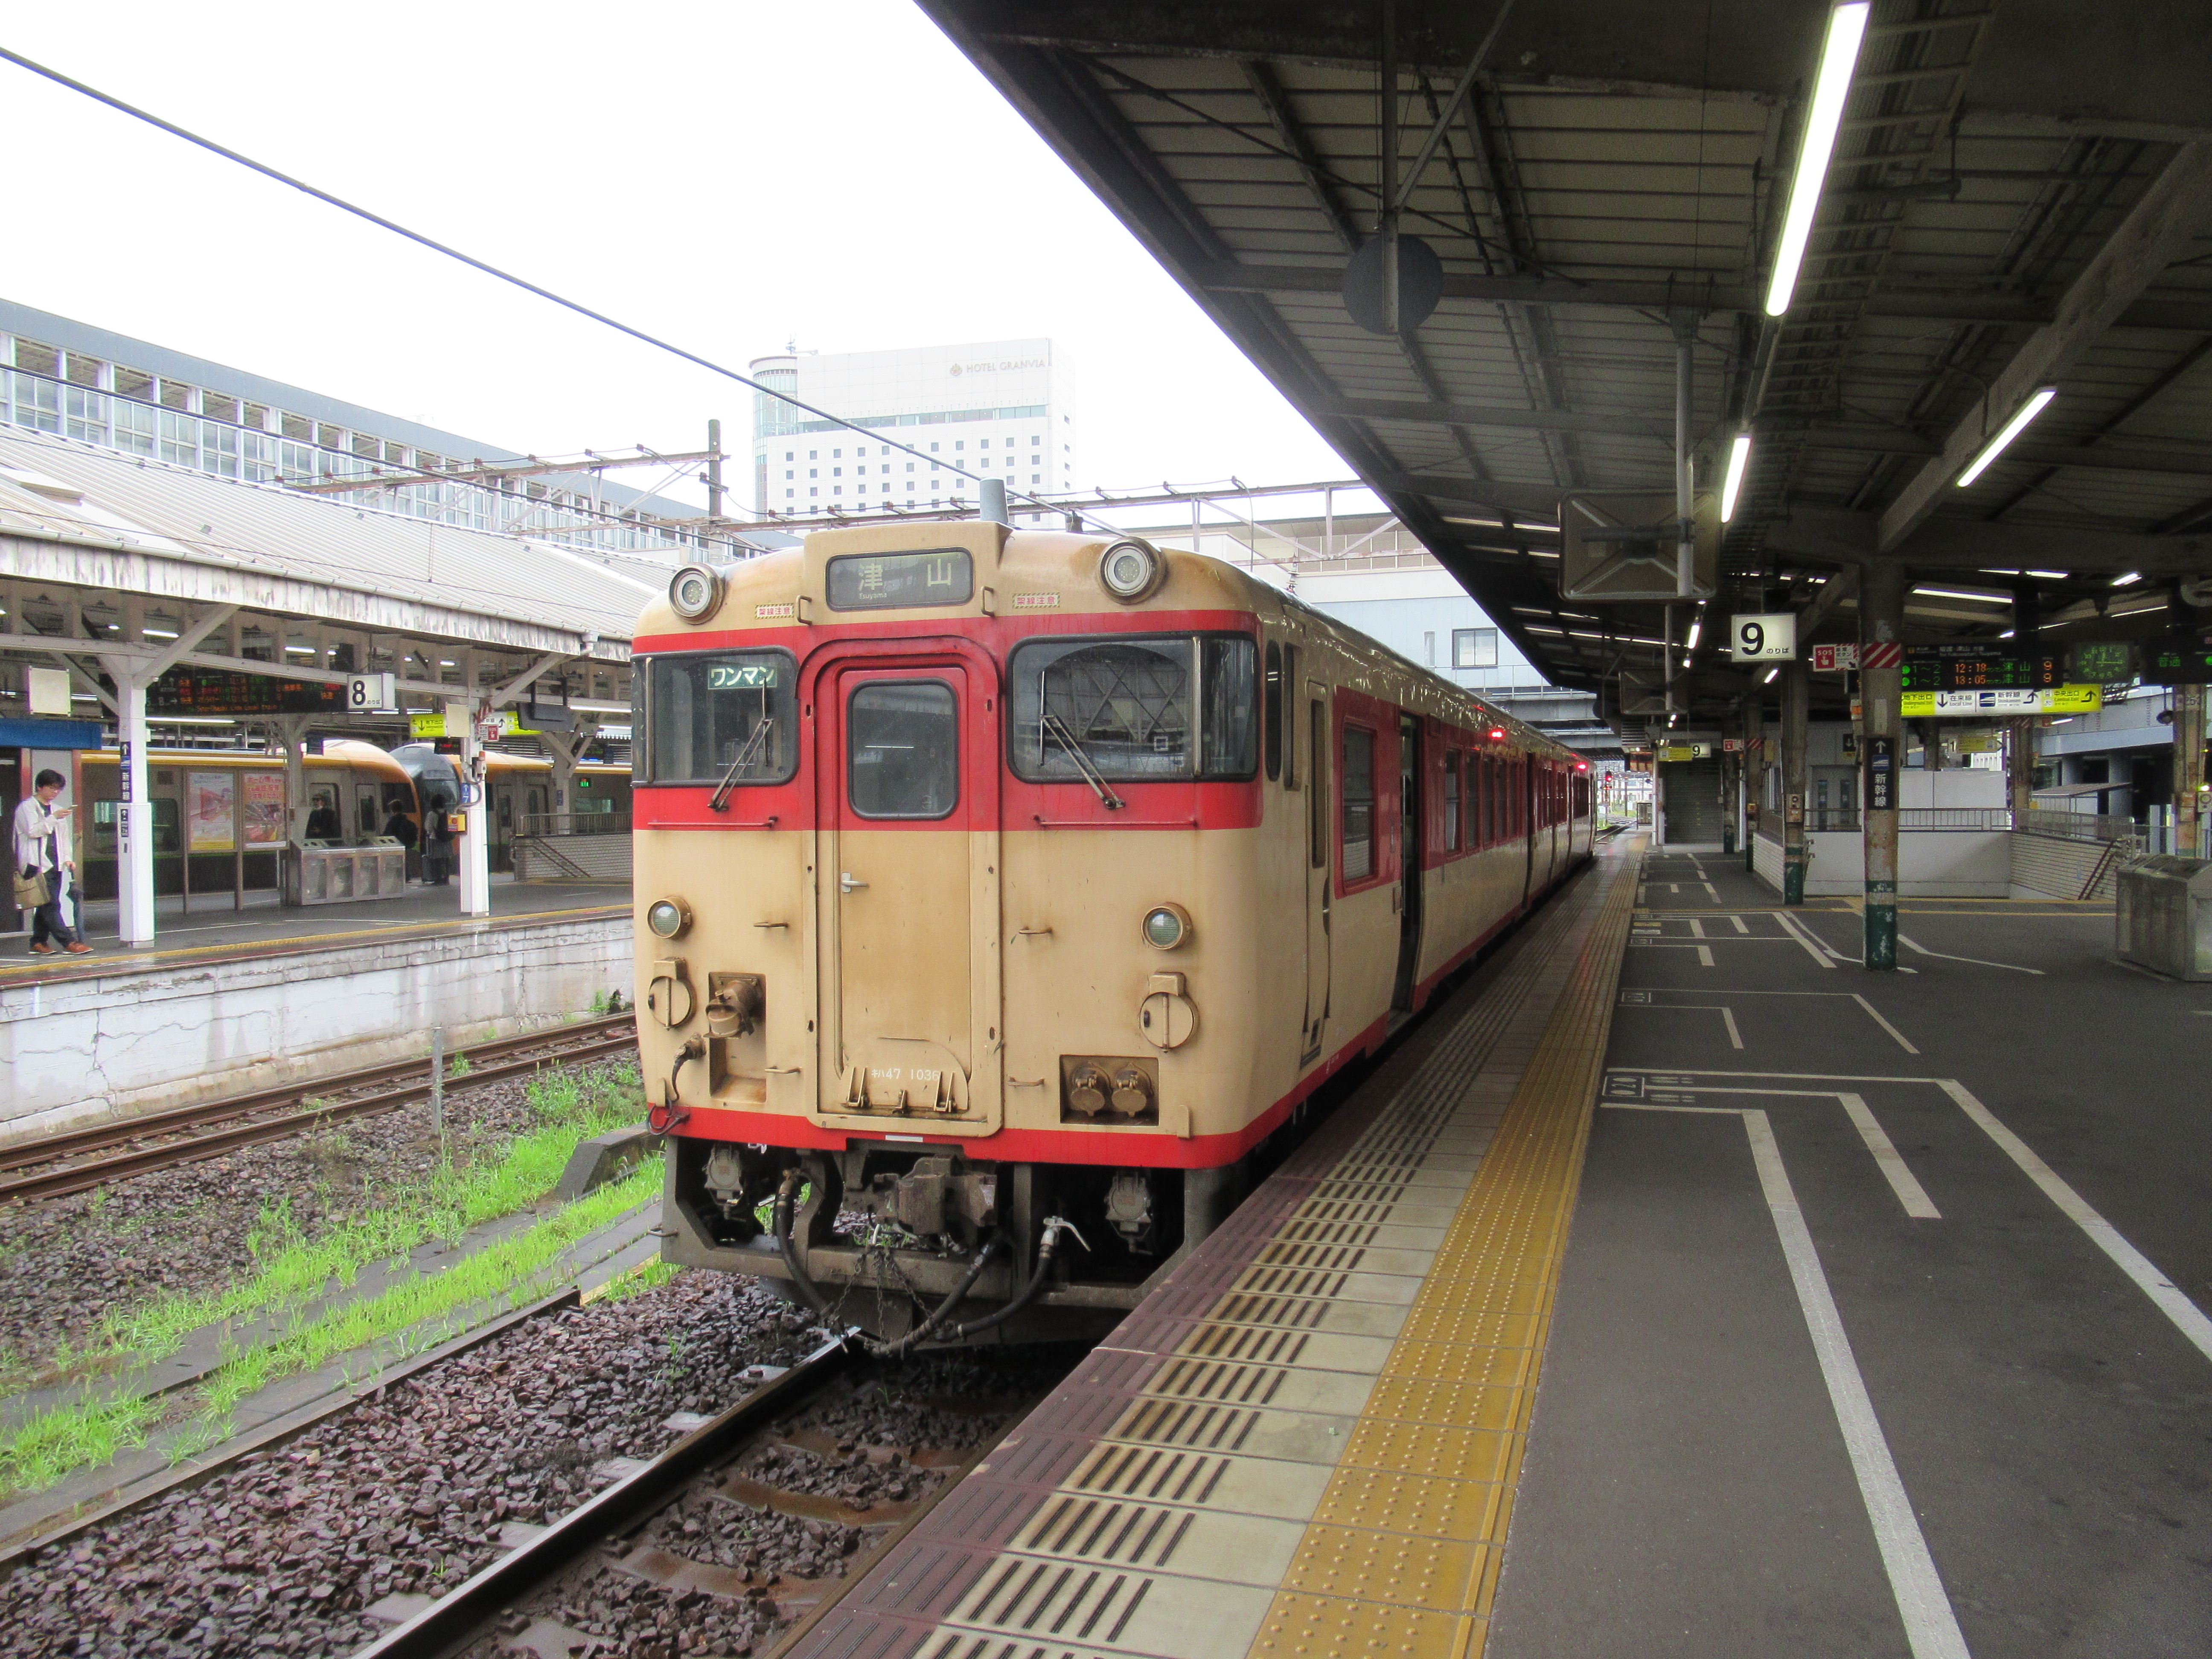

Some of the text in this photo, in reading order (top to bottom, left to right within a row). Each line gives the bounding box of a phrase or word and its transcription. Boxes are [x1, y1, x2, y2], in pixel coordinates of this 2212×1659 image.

[966, 359, 1045, 373] HOTEL GRANVIA
[1017, 596, 1055, 605] 架線注意
[1740, 622, 1764, 655] 9
[2043, 661, 2052, 670] 9
[2159, 656, 2181, 667] 普通
[1955, 663, 1987, 673] 12:18
[710, 666, 774, 687] ワンマン
[1955, 675, 1986, 685] 13:05
[2043, 673, 2052, 683] 9
[352, 680, 366, 705] 8
[1692, 745, 1700, 757] 9
[1874, 774, 1887, 806] 新幹線
[871, 1068, 940, 1080] キハ47 1036
